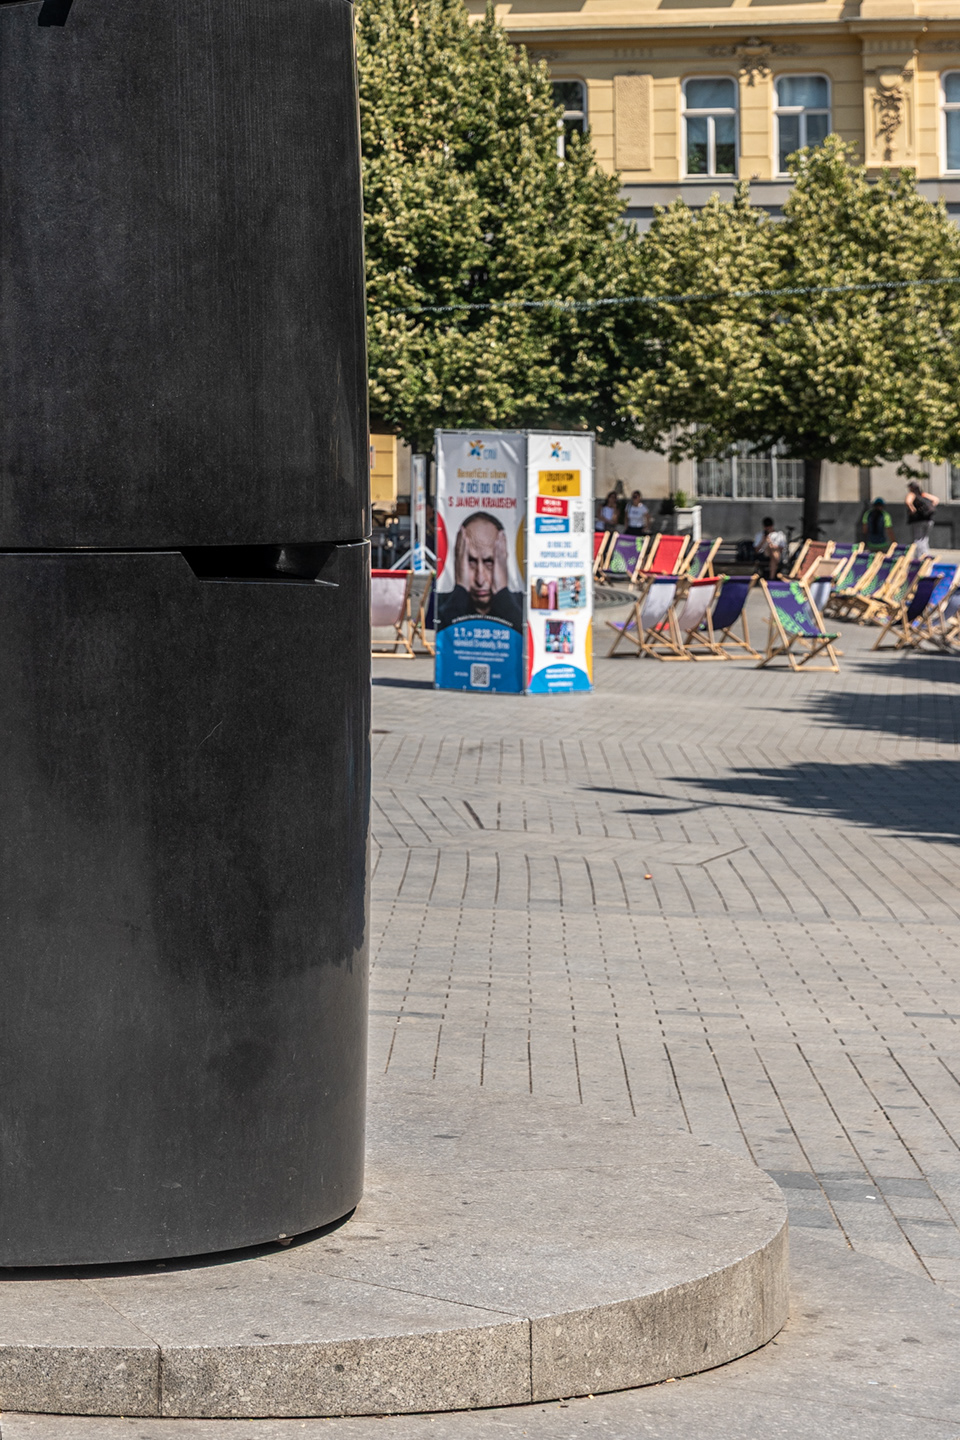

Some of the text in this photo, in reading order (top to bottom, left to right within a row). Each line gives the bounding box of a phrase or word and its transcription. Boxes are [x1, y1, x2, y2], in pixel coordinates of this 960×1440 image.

[457, 468, 508, 479] Benefiční show
[460, 479, 506, 495] Z OČÍ DO OČÍ
[448, 496, 517, 509] S JANEM KRAUSEM
